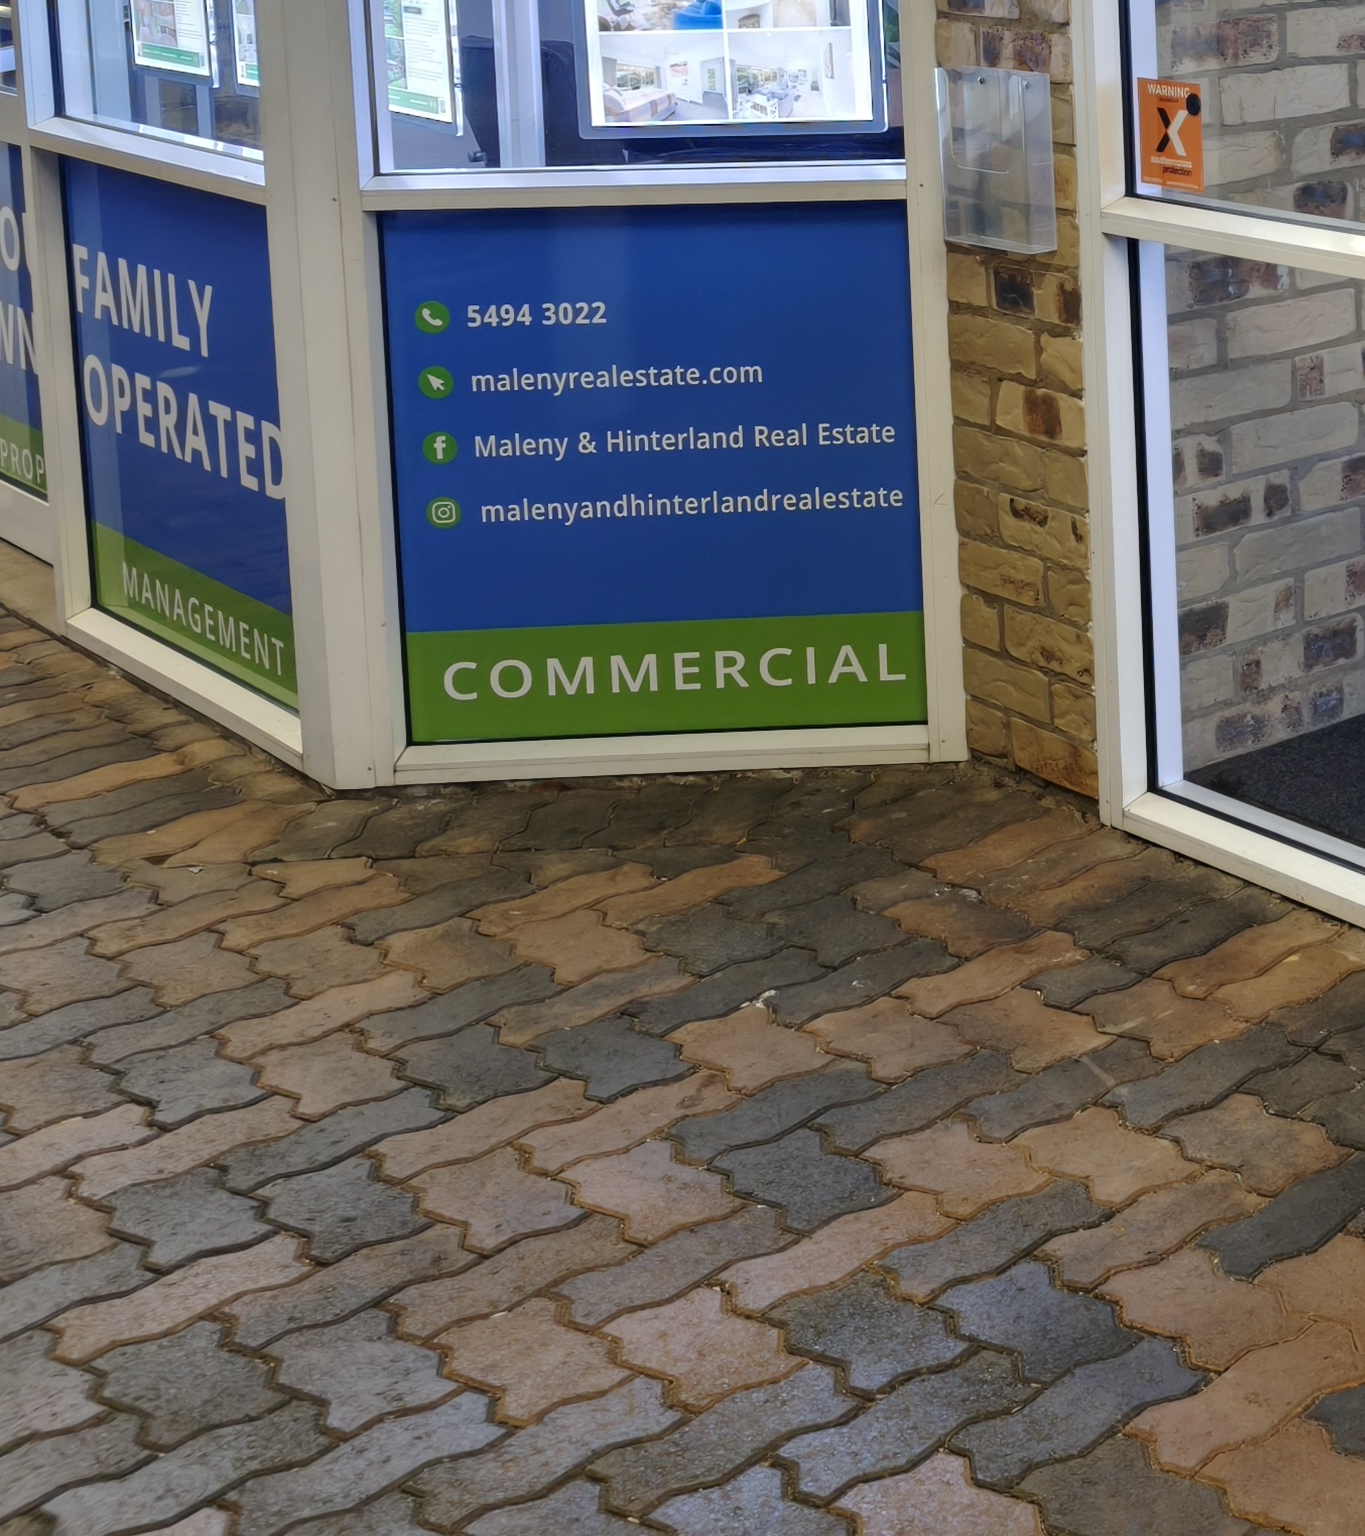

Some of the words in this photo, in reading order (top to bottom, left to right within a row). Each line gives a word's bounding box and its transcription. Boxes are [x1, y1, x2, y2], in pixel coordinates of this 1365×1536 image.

[73, 243, 213, 358] FAMILY
[467, 304, 532, 328] 5494
[541, 301, 607, 326] 3022
[471, 363, 763, 396] malenyrealestate.com
[82, 354, 285, 501] OPERATED
[474, 433, 568, 461] Maleny
[577, 432, 597, 453] &
[607, 426, 744, 454] Hinterland
[754, 423, 807, 447] Real
[818, 421, 895, 445] Estate
[481, 486, 904, 526] malenyandhinterlandrealestate
[122, 561, 285, 677] MANAGEMENT
[443, 643, 906, 701] COMMERCIAL
